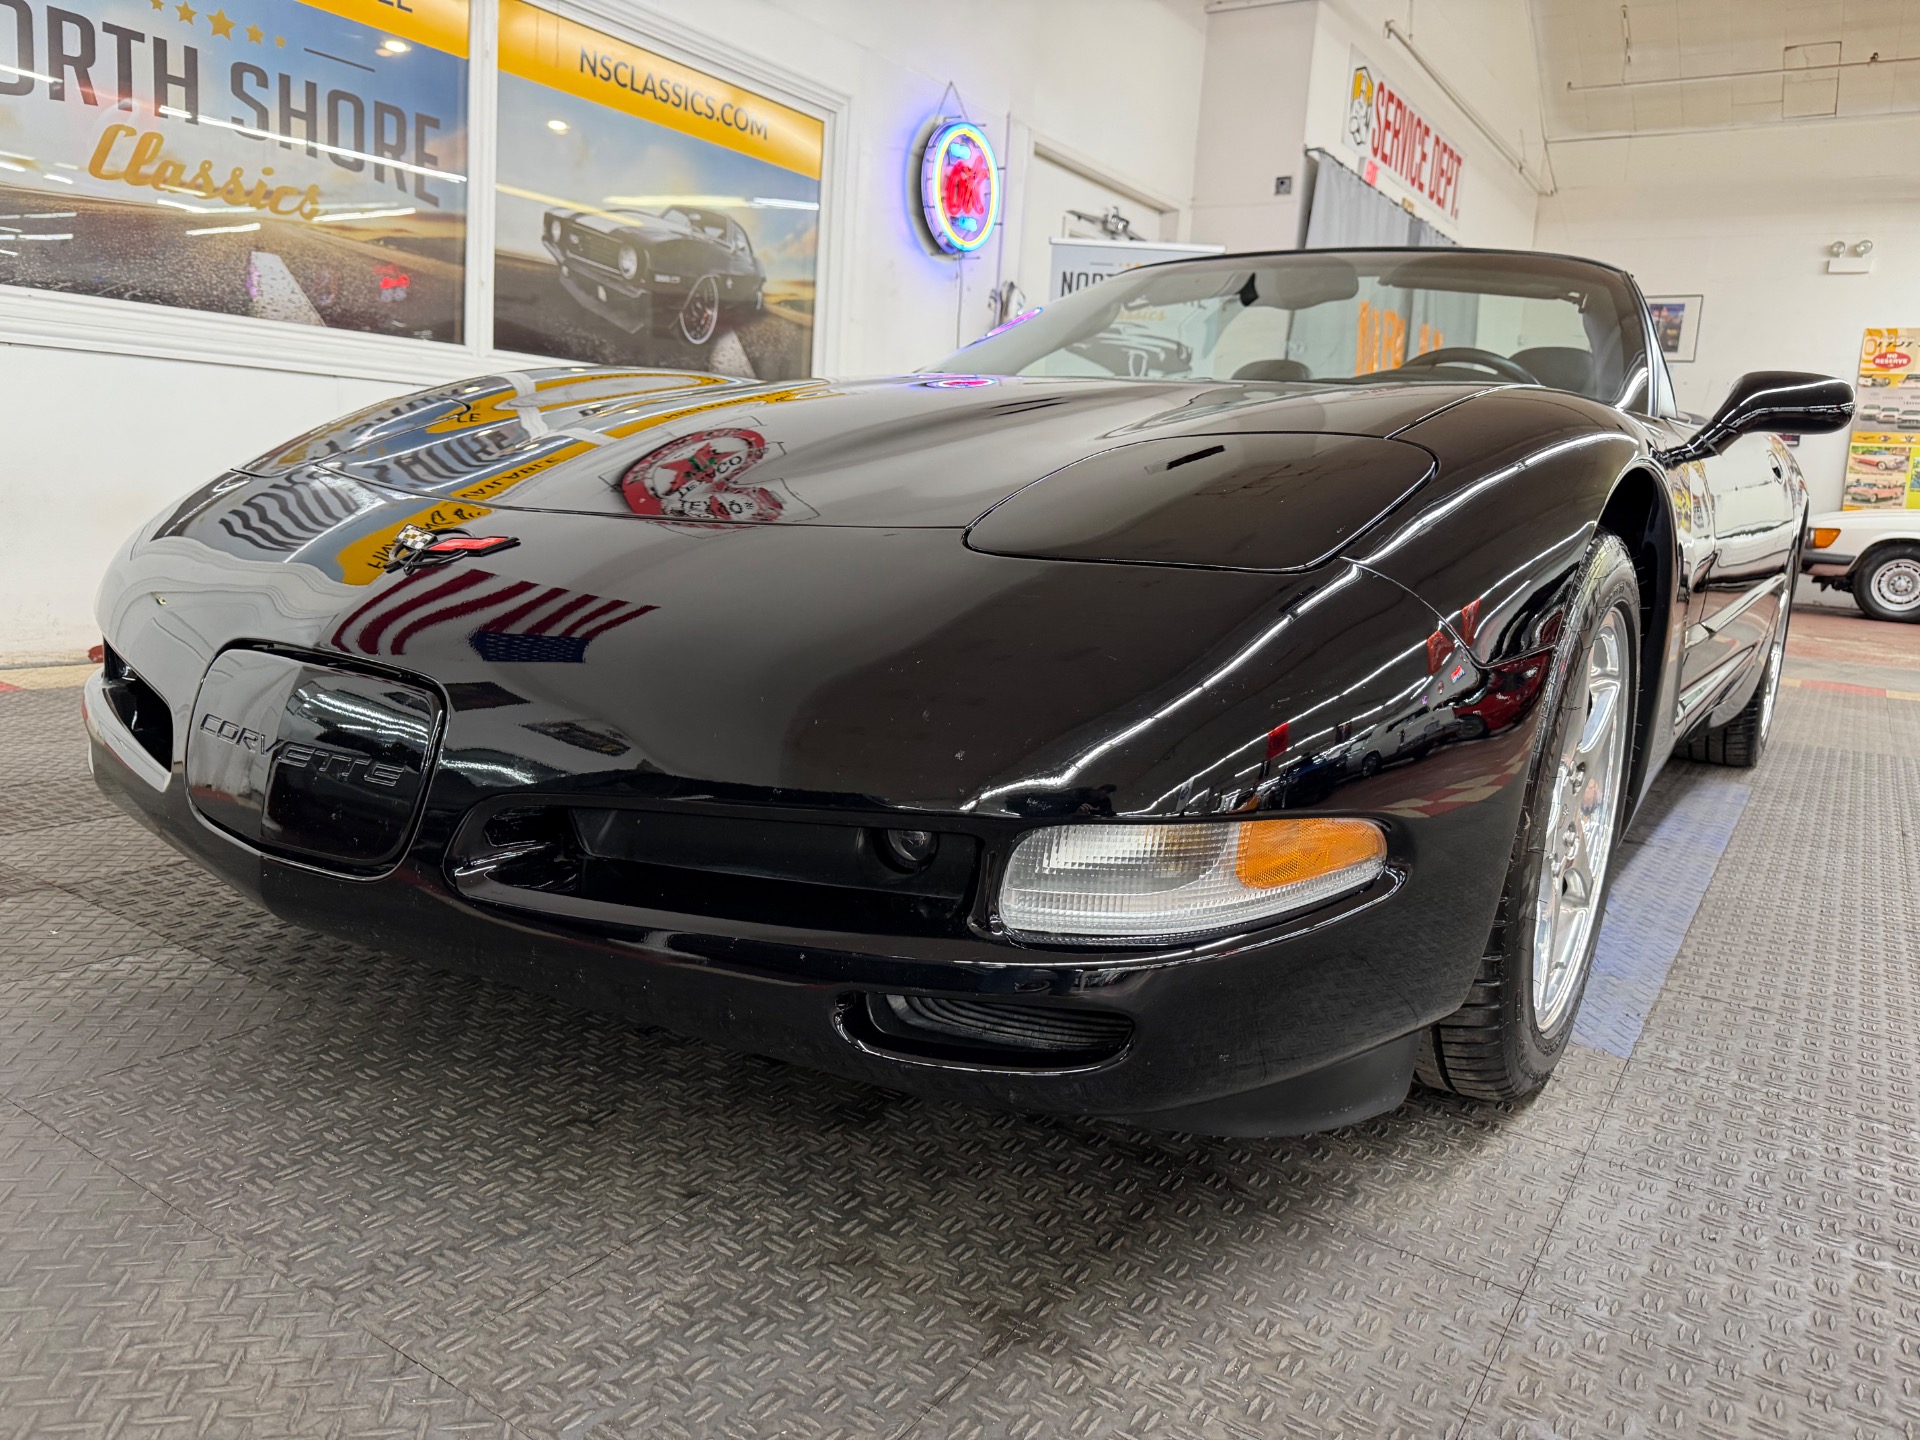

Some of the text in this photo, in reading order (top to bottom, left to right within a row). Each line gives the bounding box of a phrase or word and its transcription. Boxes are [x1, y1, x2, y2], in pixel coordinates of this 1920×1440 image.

[230, 62, 440, 208] SHORE
[579, 46, 769, 140] NSCLASSICS.COM
[88, 124, 324, 221] Classics
[1371, 81, 1463, 220] SERVICE DEPT.
[200, 713, 406, 787] CORVETTE
